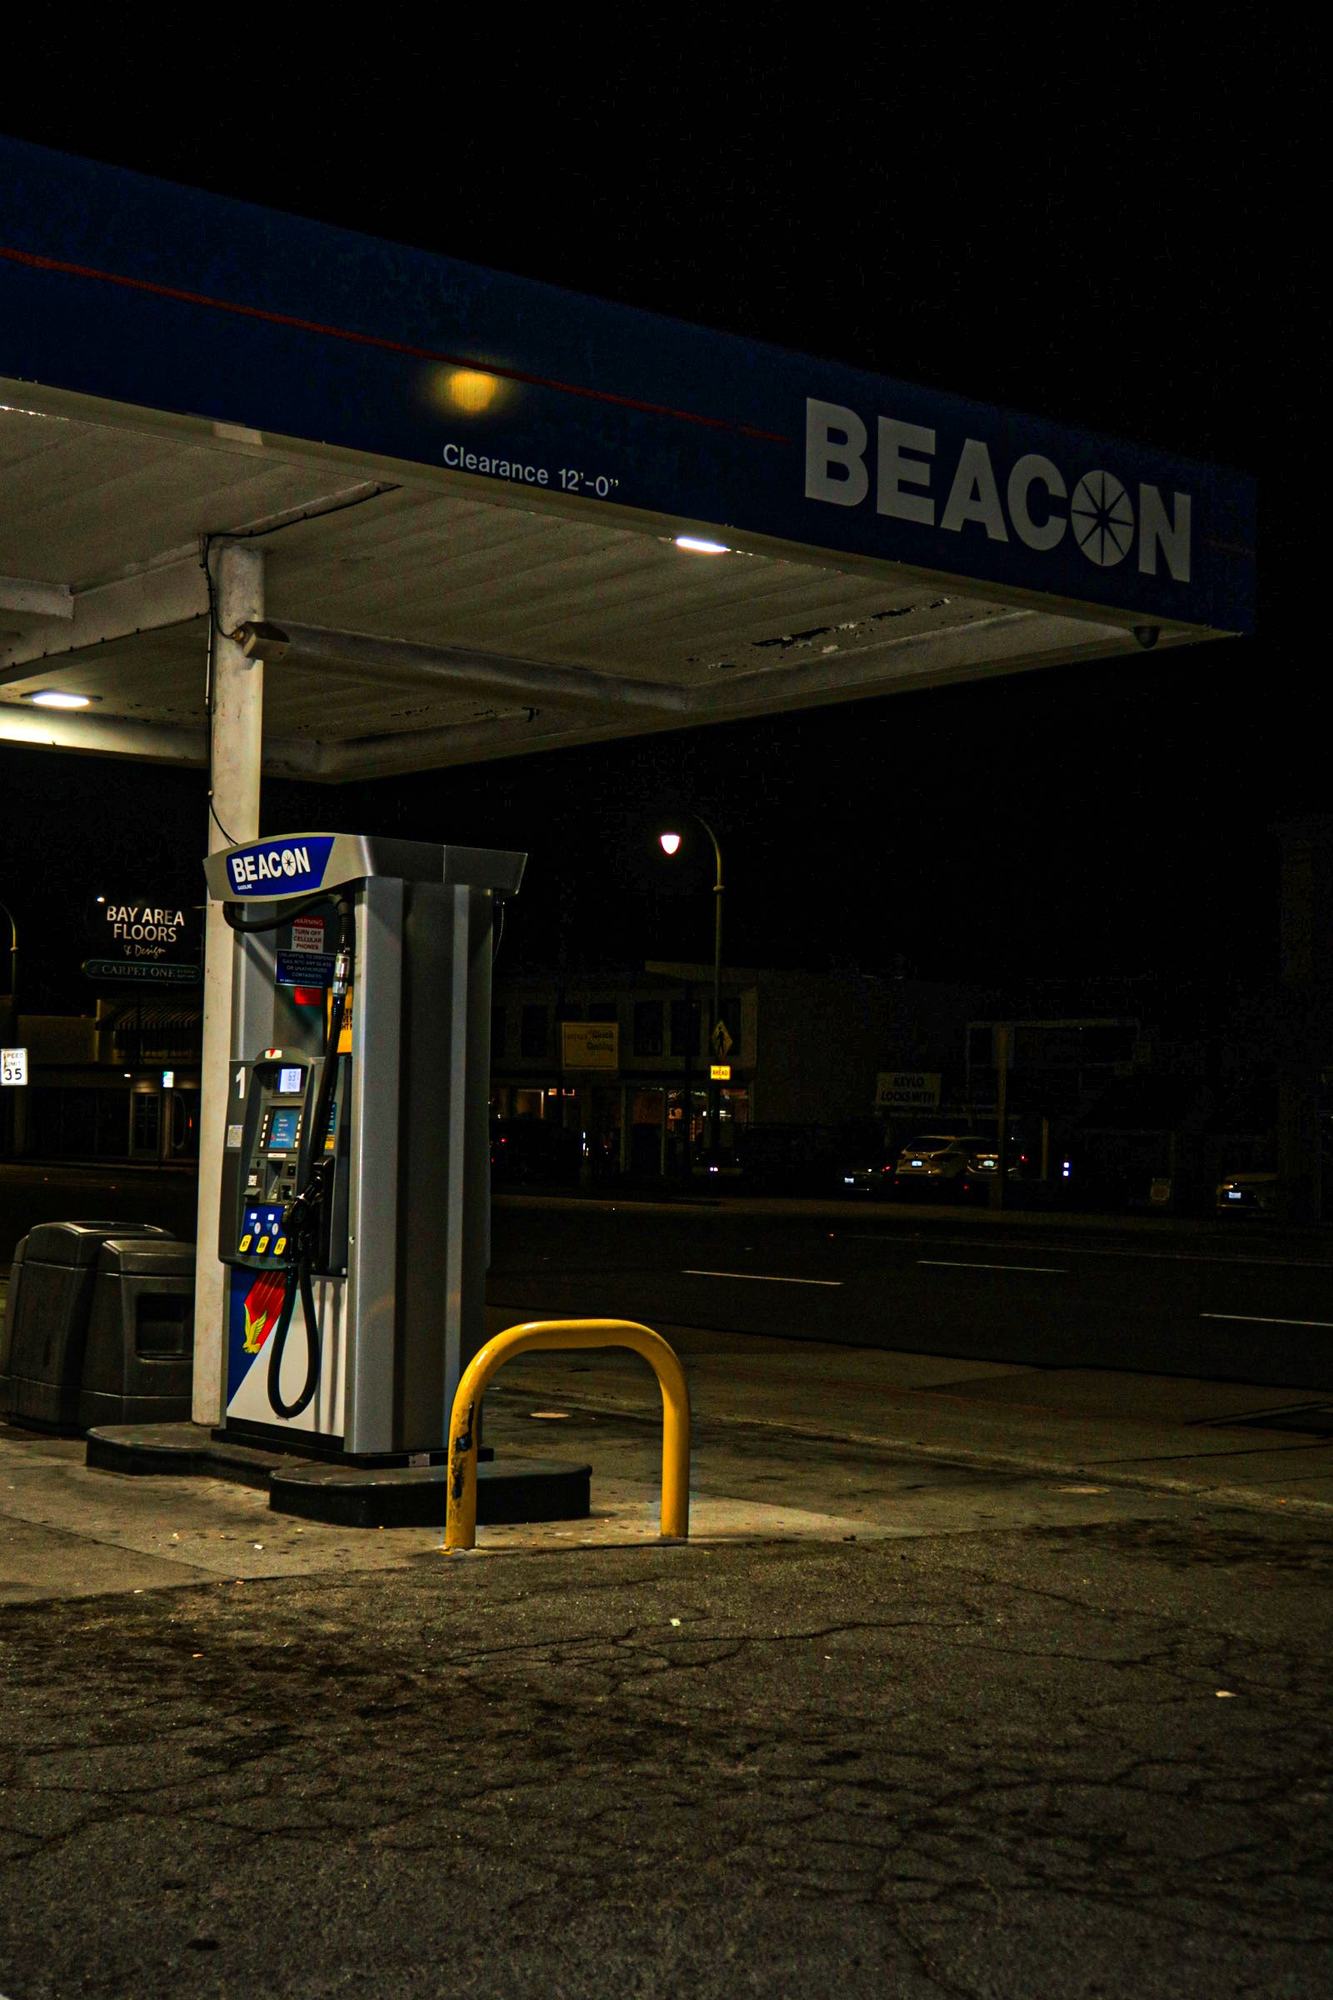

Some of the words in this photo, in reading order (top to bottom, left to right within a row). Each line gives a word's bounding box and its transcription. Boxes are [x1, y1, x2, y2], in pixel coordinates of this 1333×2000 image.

[442, 443, 549, 485] Clearance
[804, 396, 1192, 584] BEACON
[231, 846, 311, 883] BEACON
[106, 905, 138, 923] BAY
[141, 907, 185, 926] AREA
[113, 923, 177, 942] FLOORS
[102, 964, 148, 976] CARPET
[150, 967, 174, 978] ONE
[5, 1068, 22, 1081] 35
[236, 1066, 246, 1099] 1
